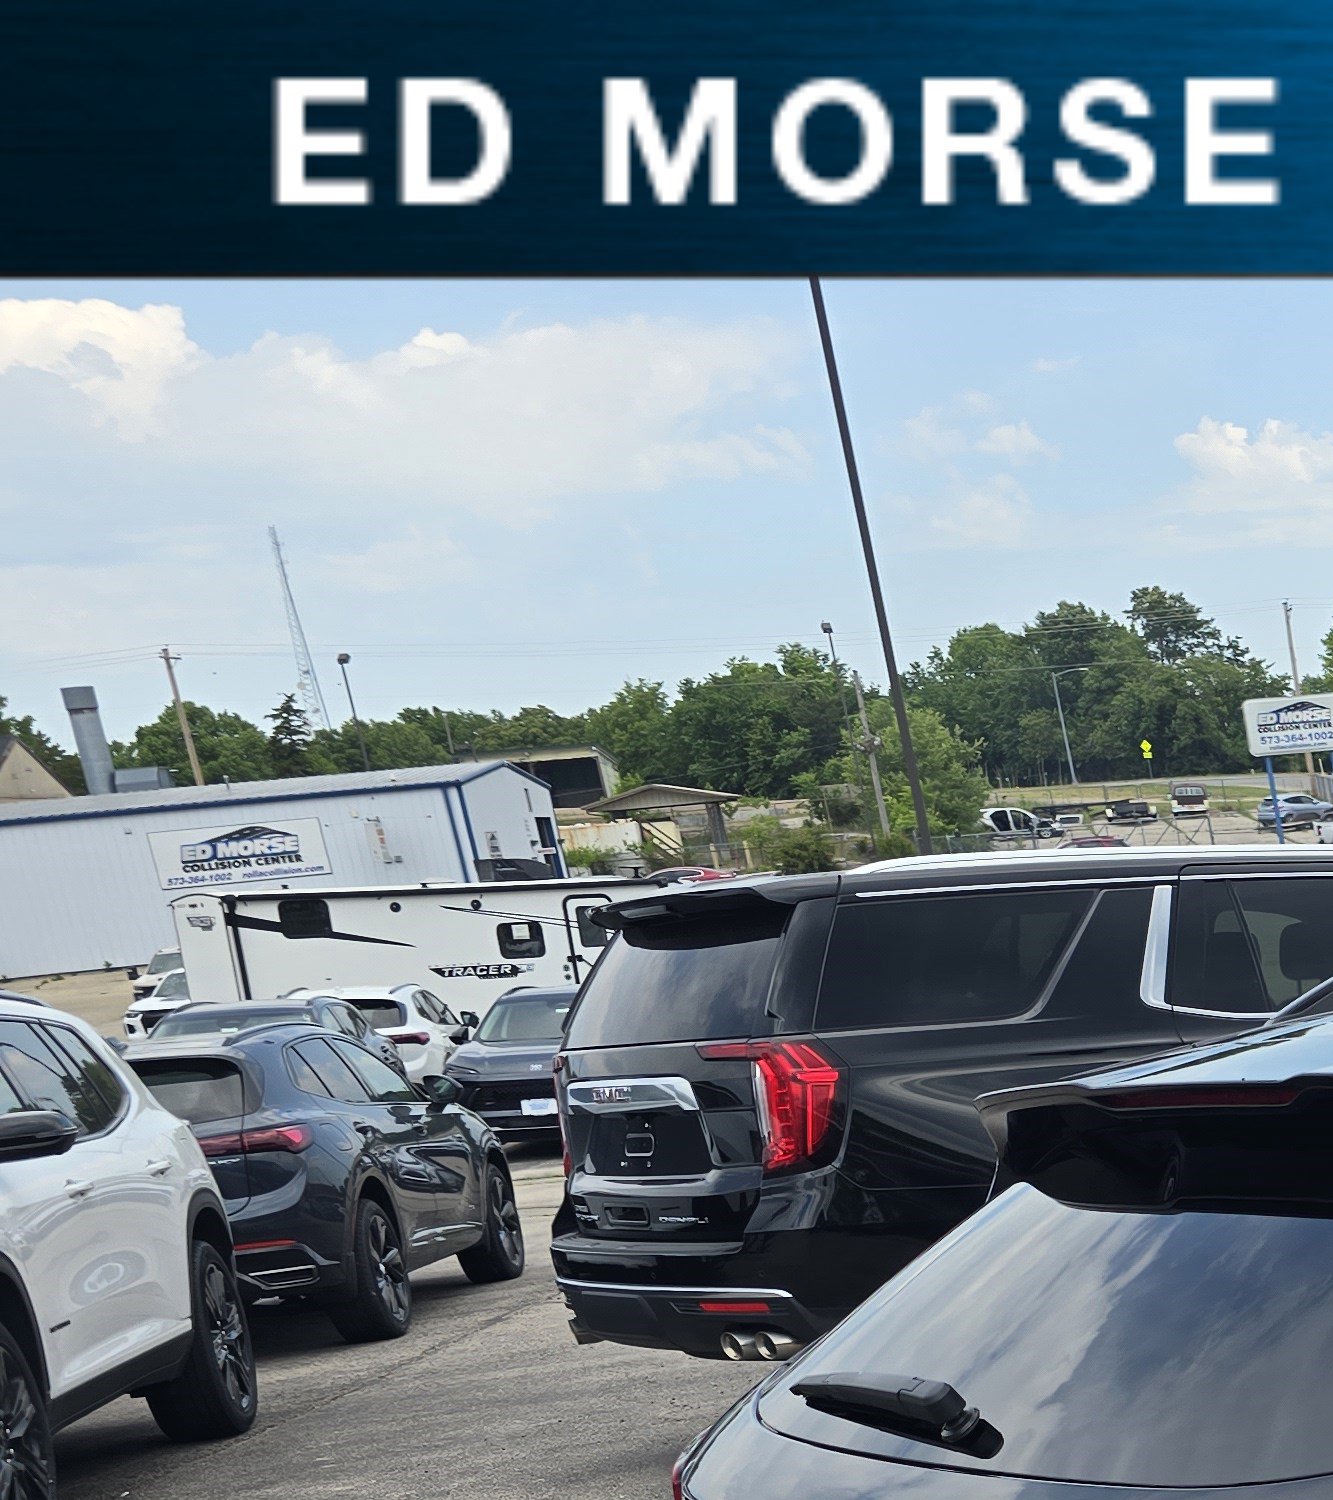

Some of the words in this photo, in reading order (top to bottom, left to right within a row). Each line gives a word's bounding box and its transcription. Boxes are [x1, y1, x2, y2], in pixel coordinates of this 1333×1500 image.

[1258, 713, 1278, 726] ED
[1279, 708, 1331, 724] MORSE
[1257, 724, 1300, 733] COLLISION
[1303, 721, 1332, 730] CENTER
[1260, 731, 1333, 745] 573-364-1002
[181, 844, 213, 863] ED
[215, 835, 299, 860] MORSE
[182, 859, 252, 873] COLLISION
[255, 854, 304, 866] CENTER
[167, 872, 232, 886] 573-364-1002
[442, 964, 512, 977] TRACER
[592, 1086, 631, 1103] GMC
